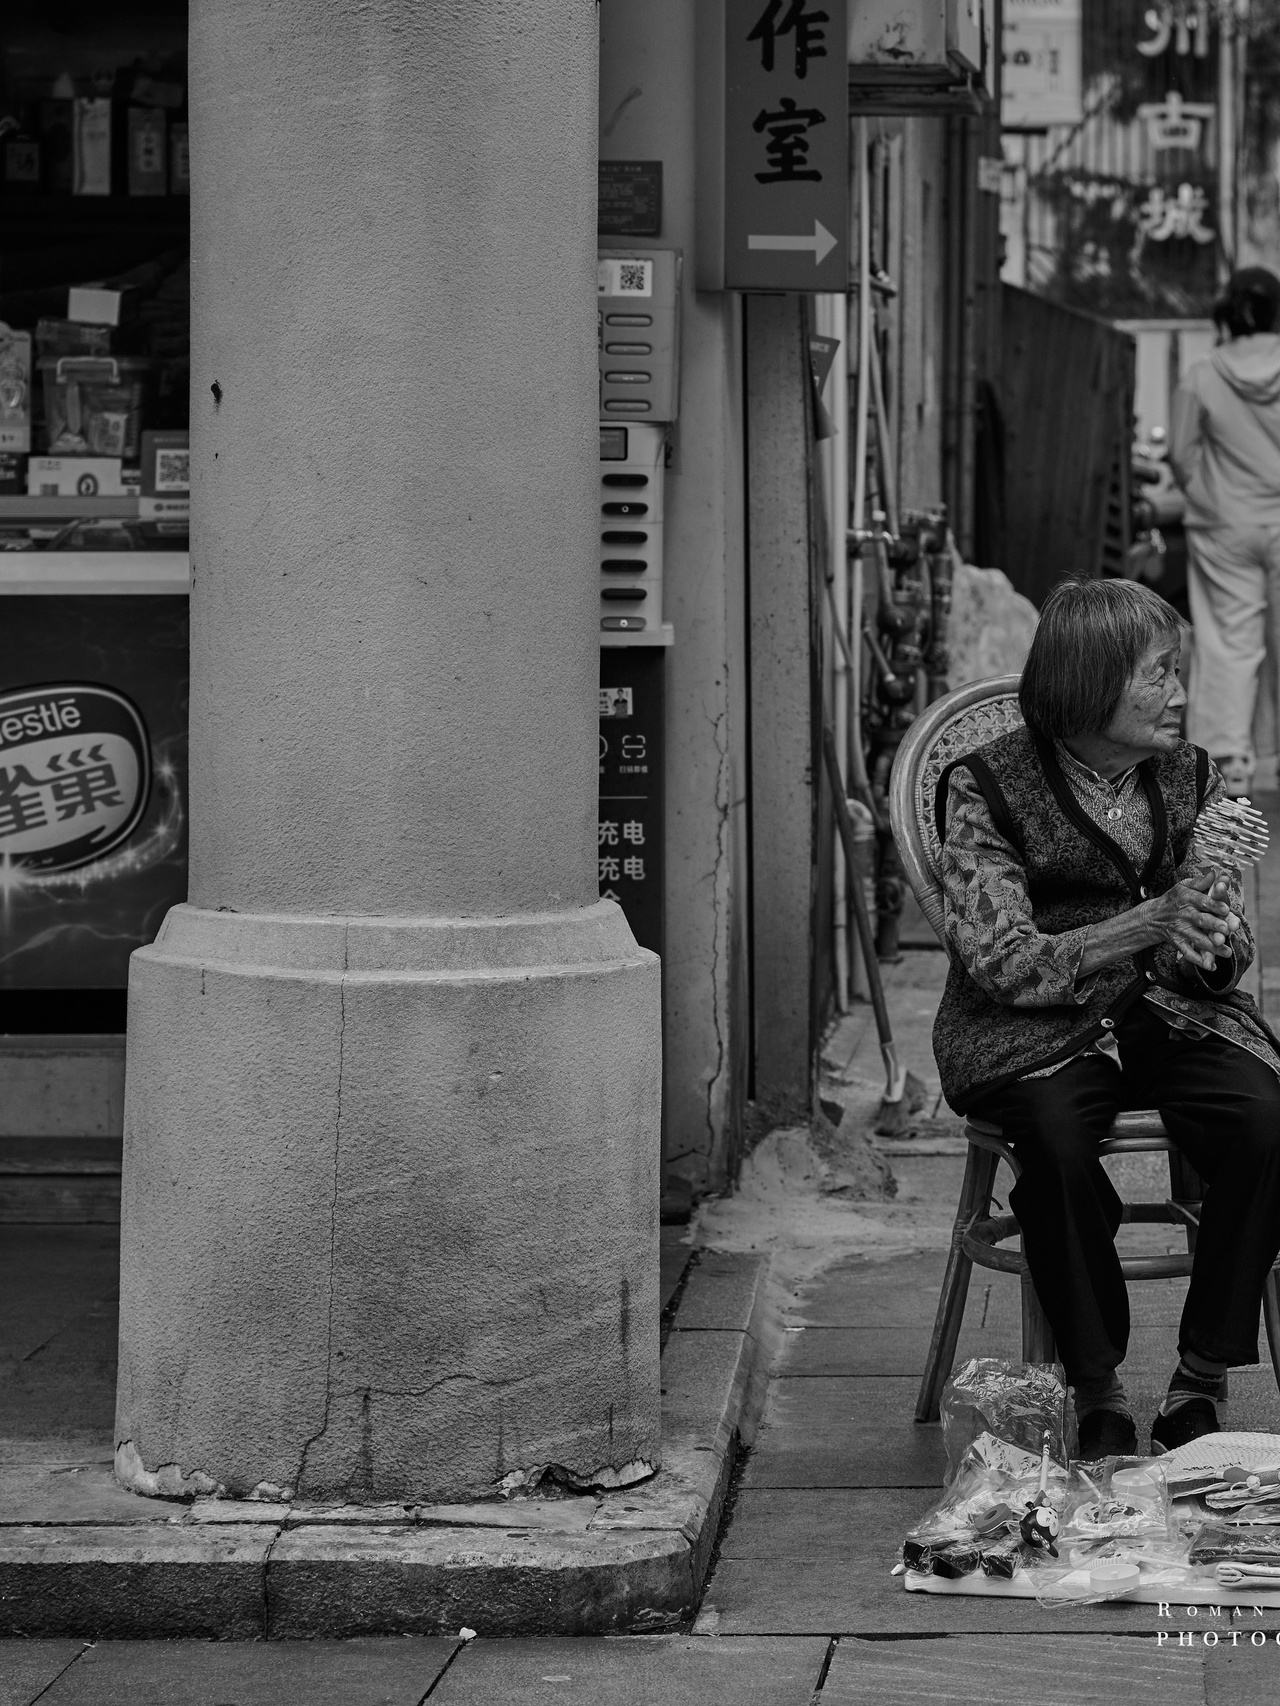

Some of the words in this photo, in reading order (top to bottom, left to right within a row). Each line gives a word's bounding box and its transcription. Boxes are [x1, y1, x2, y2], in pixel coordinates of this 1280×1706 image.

[747, 0, 830, 184] 作室
[0, 698, 82, 745] estlé
[598, 820, 646, 845] 充电
[599, 855, 646, 881] 充电
